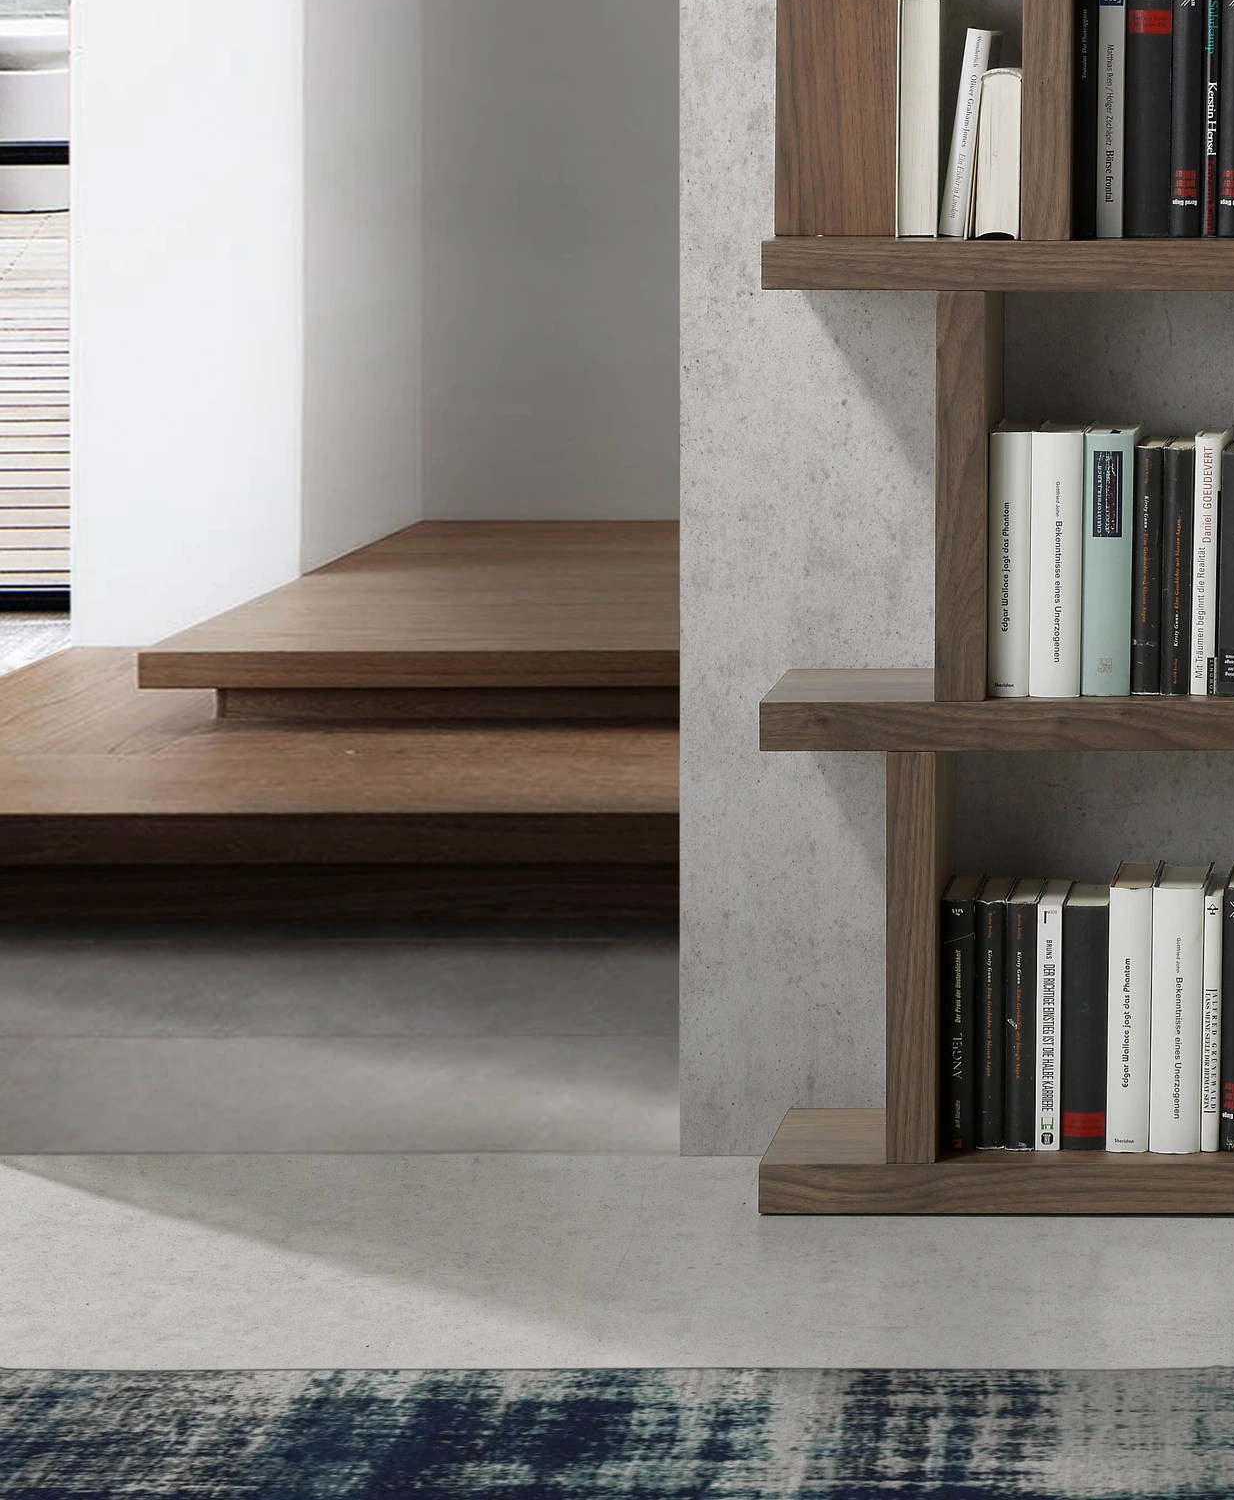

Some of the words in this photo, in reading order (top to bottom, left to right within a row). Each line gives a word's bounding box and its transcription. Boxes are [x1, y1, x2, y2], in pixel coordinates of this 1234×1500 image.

[1206, 0, 1218, 55] Suhrkamp
[973, 36, 982, 68] Wunderlich
[1106, 44, 1114, 72] Matthias
[968, 74, 977, 96] Oliver
[1106, 72, 1114, 86] Iken
[1104, 93, 1114, 114] Holger
[1207, 81, 1217, 119] Kerstin
[961, 98, 974, 148] Graham-Jones
[1104, 115, 1114, 146] Zschäpitz
[1206, 120, 1217, 156] Hensel
[957, 153, 966, 165] Ein
[1105, 150, 1114, 174] Börse
[954, 166, 965, 187] Eisbär
[1105, 176, 1114, 203] frontal
[950, 194, 960, 219] London
[1203, 447, 1213, 509] GOEUDEVERT
[1202, 514, 1211, 543] Daniel
[1001, 555, 1011, 572] jagt
[1197, 547, 1206, 578] Realität
[1001, 574, 1009, 606] Wallace
[1197, 581, 1205, 593] die
[1001, 608, 1011, 632] Edgar
[1196, 595, 1206, 626] beginnt
[1195, 628, 1204, 663] Träumen
[1195, 665, 1203, 679] Mit
[1043, 964, 1055, 977] DER
[1043, 977, 1056, 1006] RICHTIGE
[1042, 1007, 1055, 1035] EINSTIEG
[1042, 1035, 1055, 1046] IST
[1042, 1047, 1055, 1058] DIE
[1042, 1058, 1055, 1079] HALBE
[1041, 1080, 1054, 1112] KARRIERE
